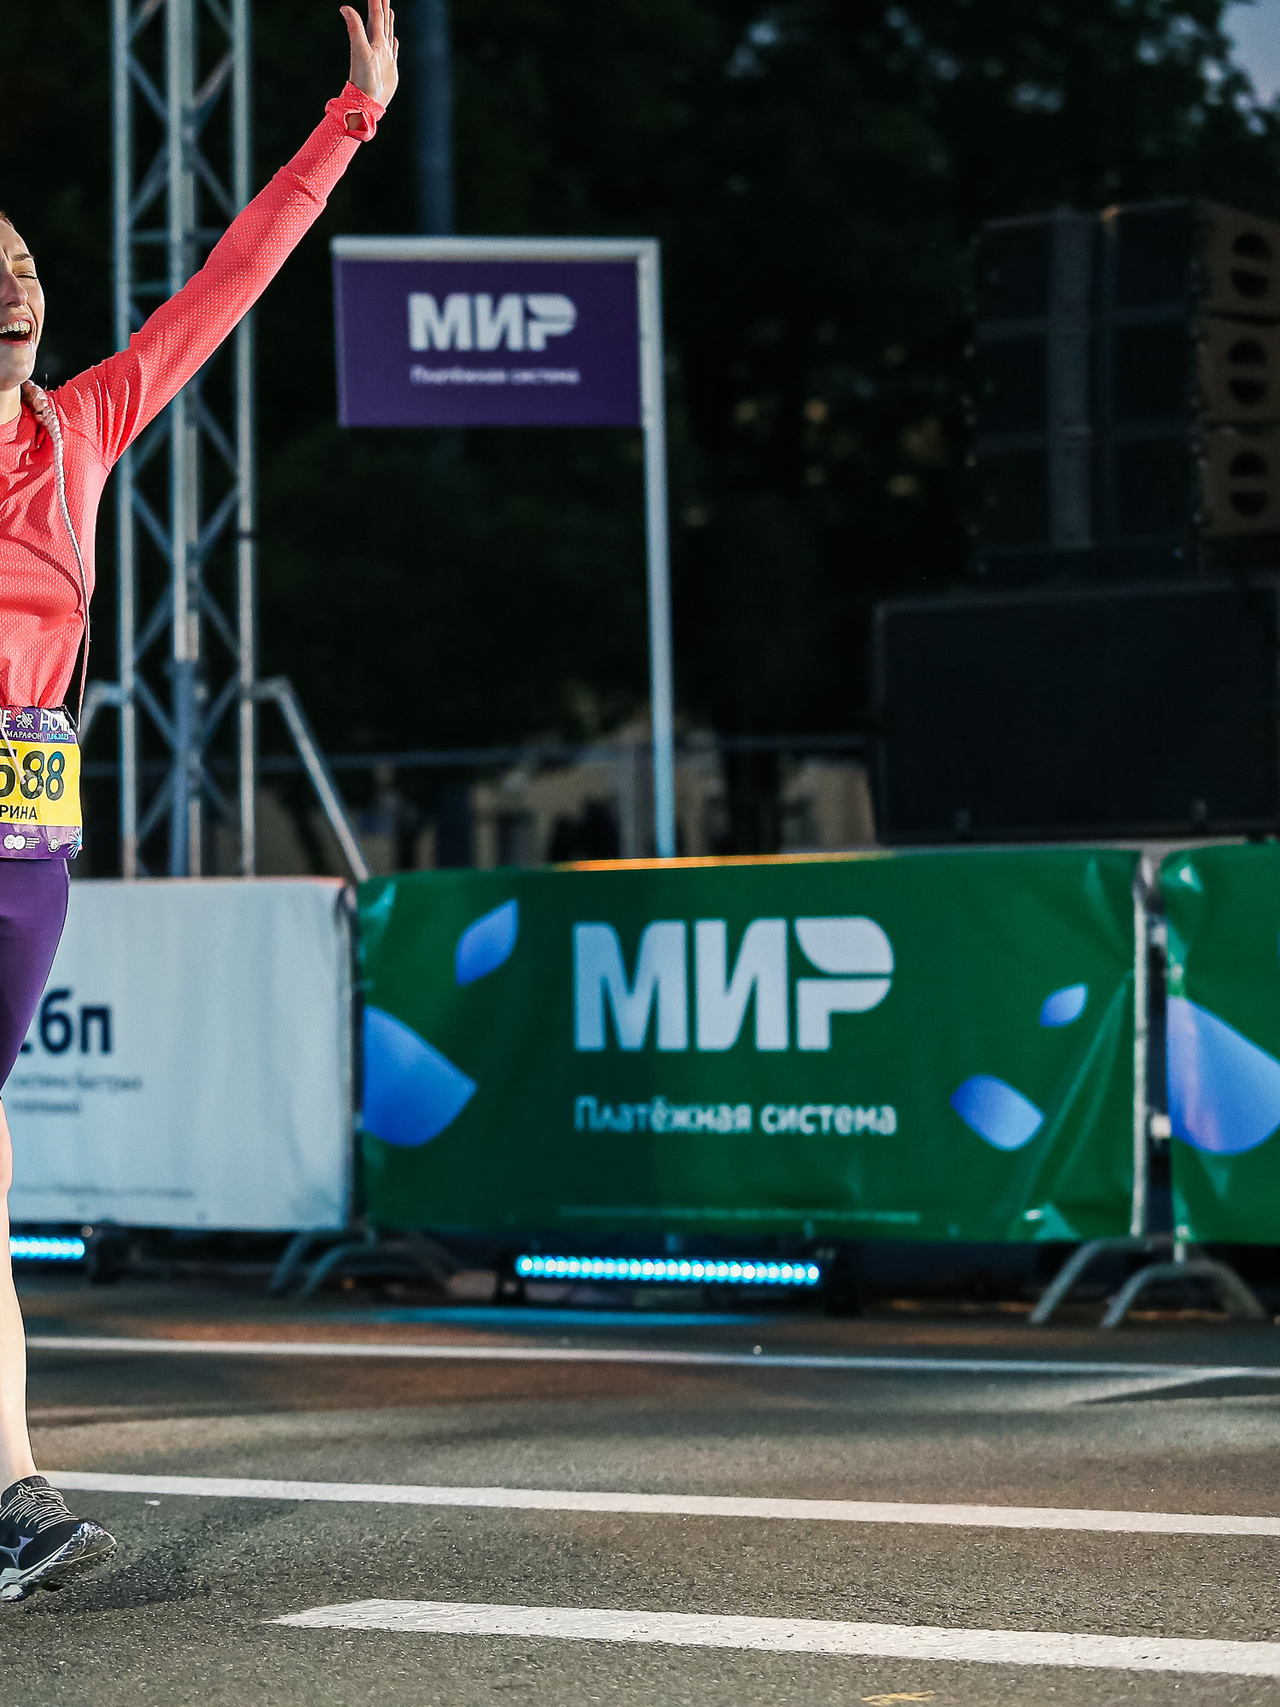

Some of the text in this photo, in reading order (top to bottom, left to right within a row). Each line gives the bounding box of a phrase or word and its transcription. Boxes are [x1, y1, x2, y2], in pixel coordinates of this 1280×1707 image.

[408, 292, 577, 351] МИР
[6, 730, 42, 740] МАРАФОН
[572, 916, 895, 1052] МИР
[19, 987, 113, 1056] бп
[574, 1095, 898, 1136] Платёжная система
